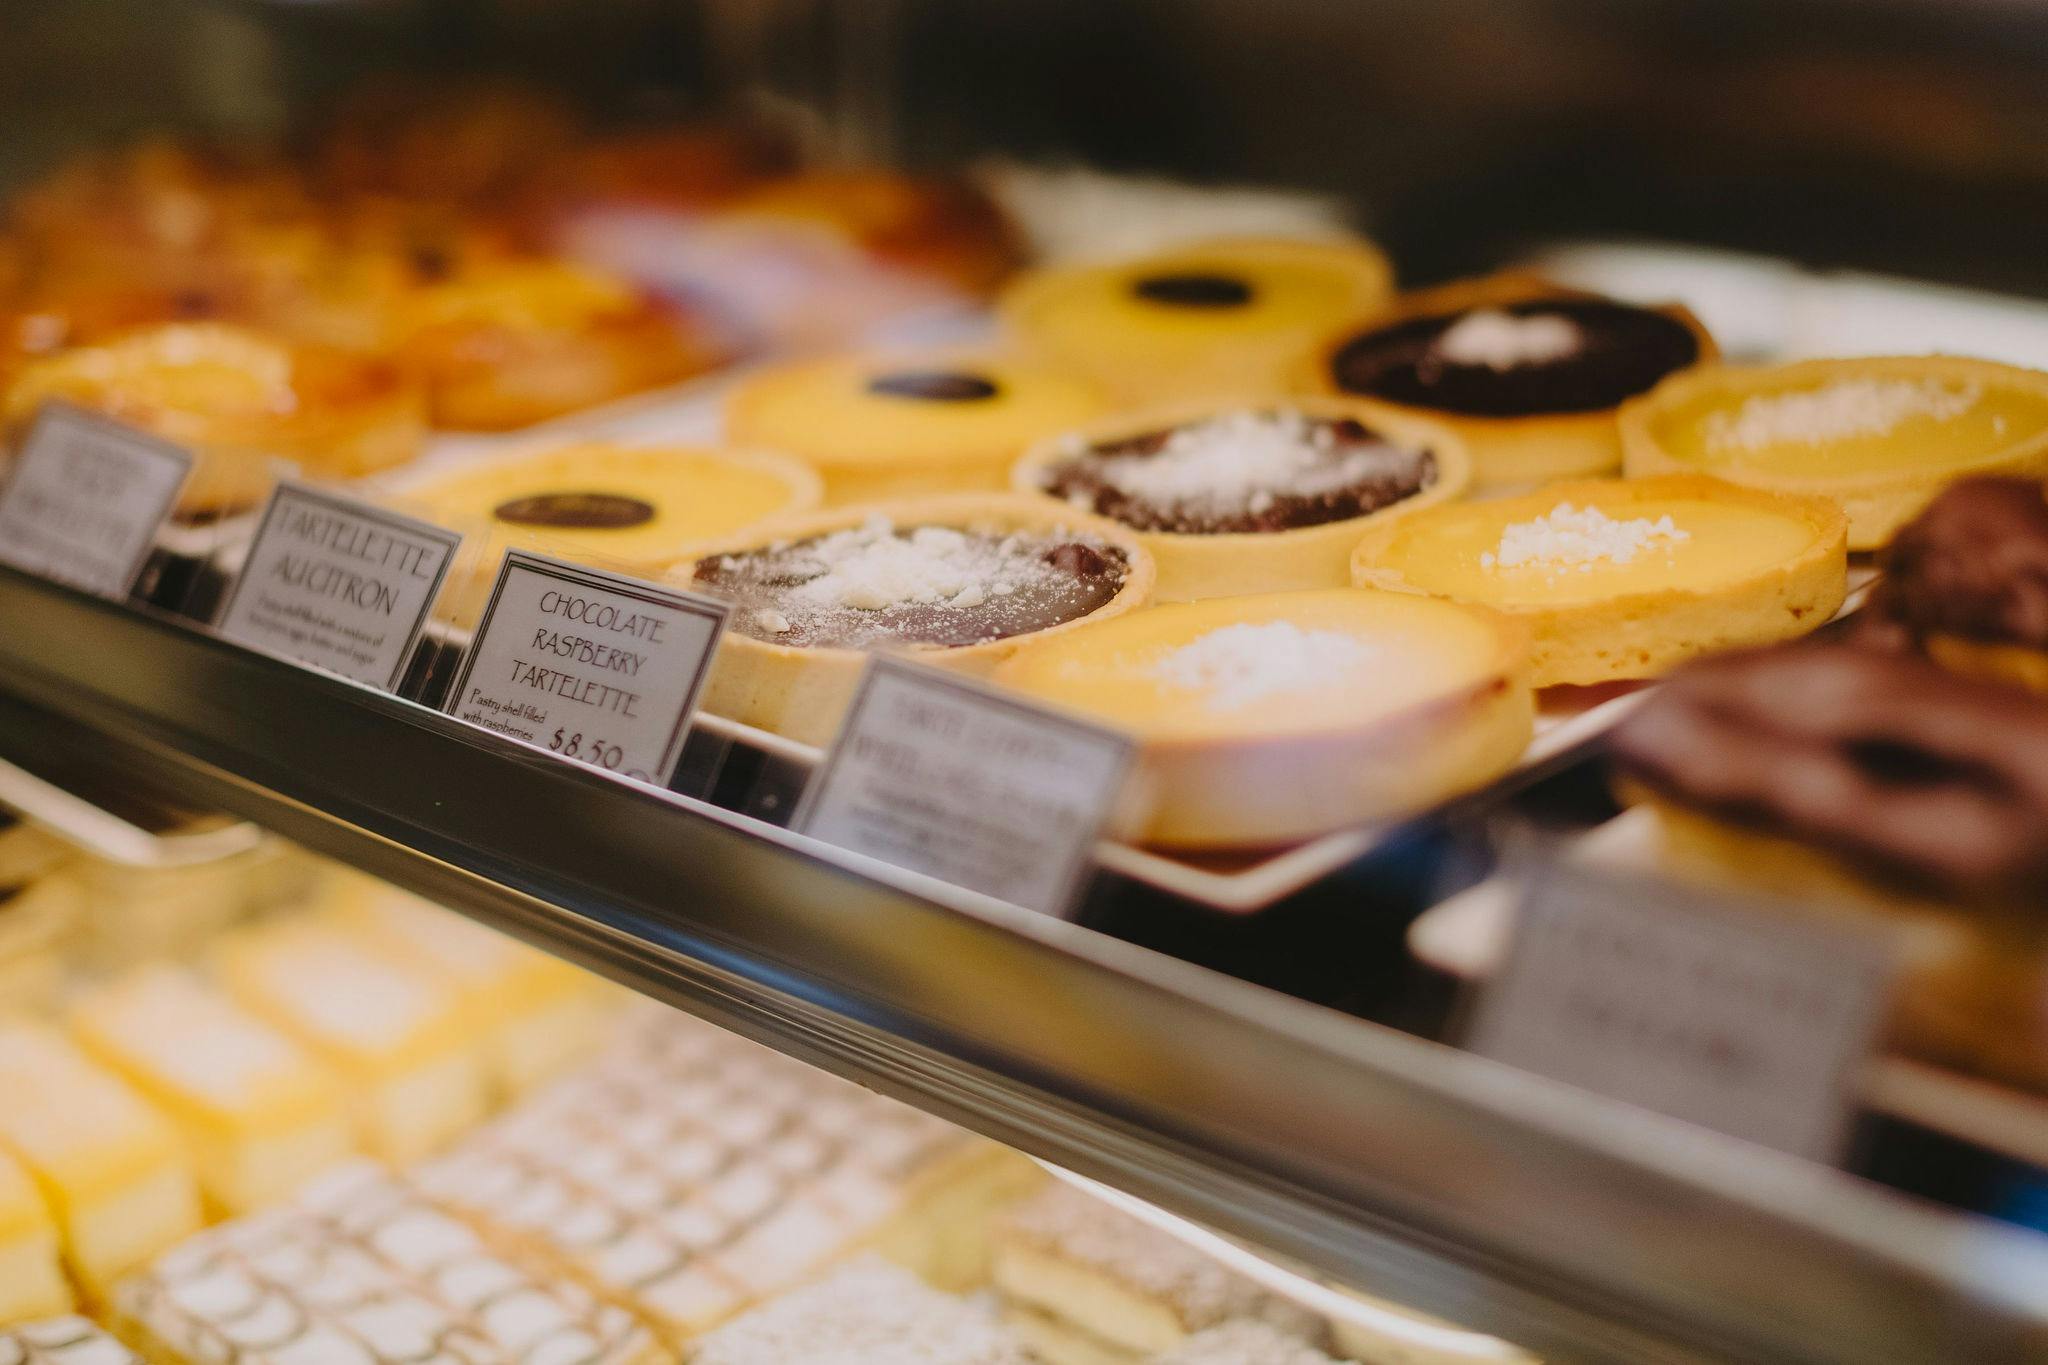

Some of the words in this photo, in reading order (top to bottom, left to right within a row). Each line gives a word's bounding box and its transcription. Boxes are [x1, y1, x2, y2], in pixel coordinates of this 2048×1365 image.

[277, 503, 435, 580] TARTELETTE
[540, 591, 668, 644] CHOCOLATE
[532, 628, 648, 677] RASPBERRY
[469, 688, 501, 714] Pastry
[501, 700, 524, 718] shell
[523, 705, 548, 724] filled
[510, 659, 642, 718] TARTELETTE
[463, 710, 483, 726] with
[482, 719, 534, 741] raspberries
[549, 726, 623, 769] $8.50
